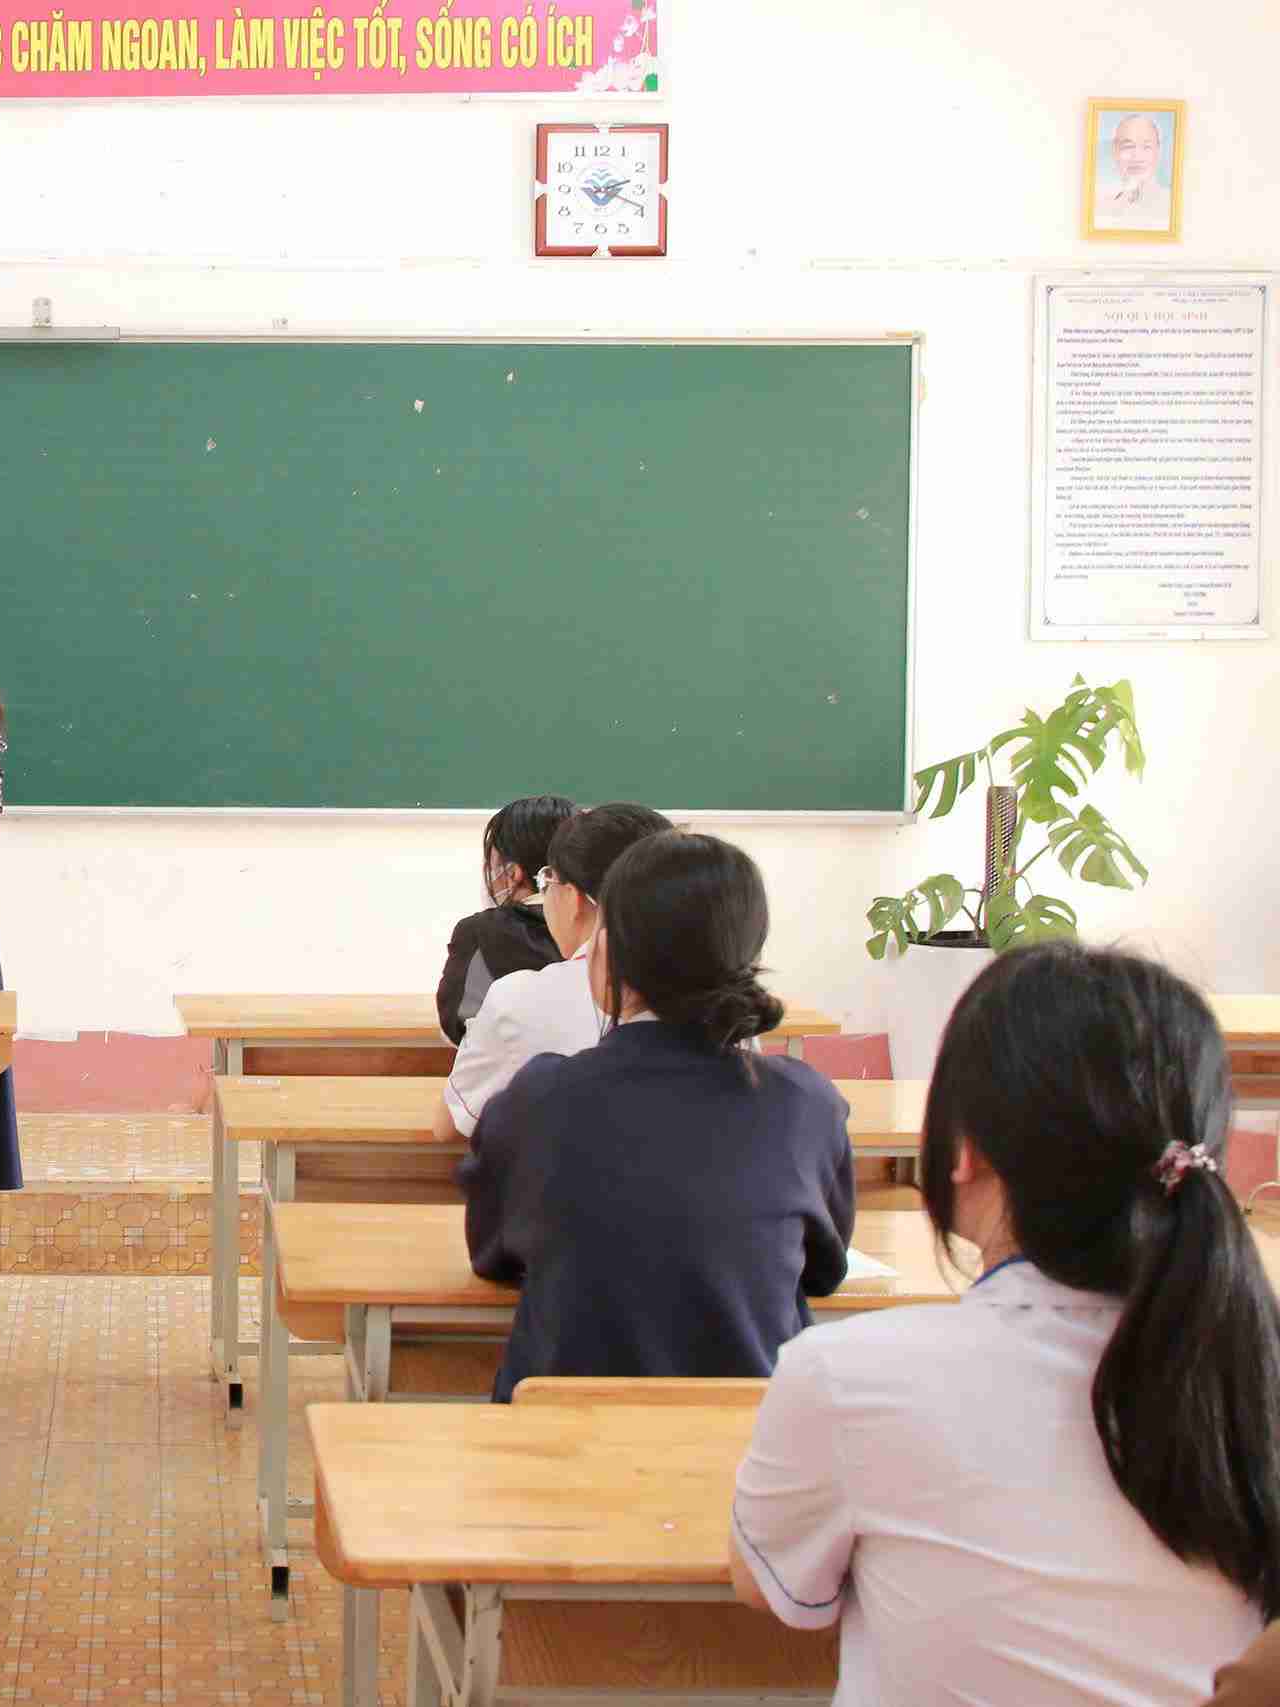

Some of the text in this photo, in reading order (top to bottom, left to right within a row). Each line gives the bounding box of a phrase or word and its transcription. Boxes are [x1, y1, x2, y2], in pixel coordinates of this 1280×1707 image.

[11, 9, 93, 73] CHĂM
[101, 18, 206, 77] NGOAN,
[215, 7, 275, 70] LÀM
[283, 6, 345, 81] VIỆC
[353, 0, 407, 75] TỐT,
[415, 0, 492, 70] SỐNG
[500, 5, 539, 69] CÓ
[546, 3, 593, 68] ÍCH
[574, 145, 626, 157] 11 12 1
[557, 161, 573, 173] 10
[634, 161, 646, 173] 2
[558, 184, 571, 194] 9
[633, 184, 645, 196] 3
[558, 205, 571, 217] 8
[634, 206, 645, 218] 4
[574, 222, 630, 234] 7 6 5
